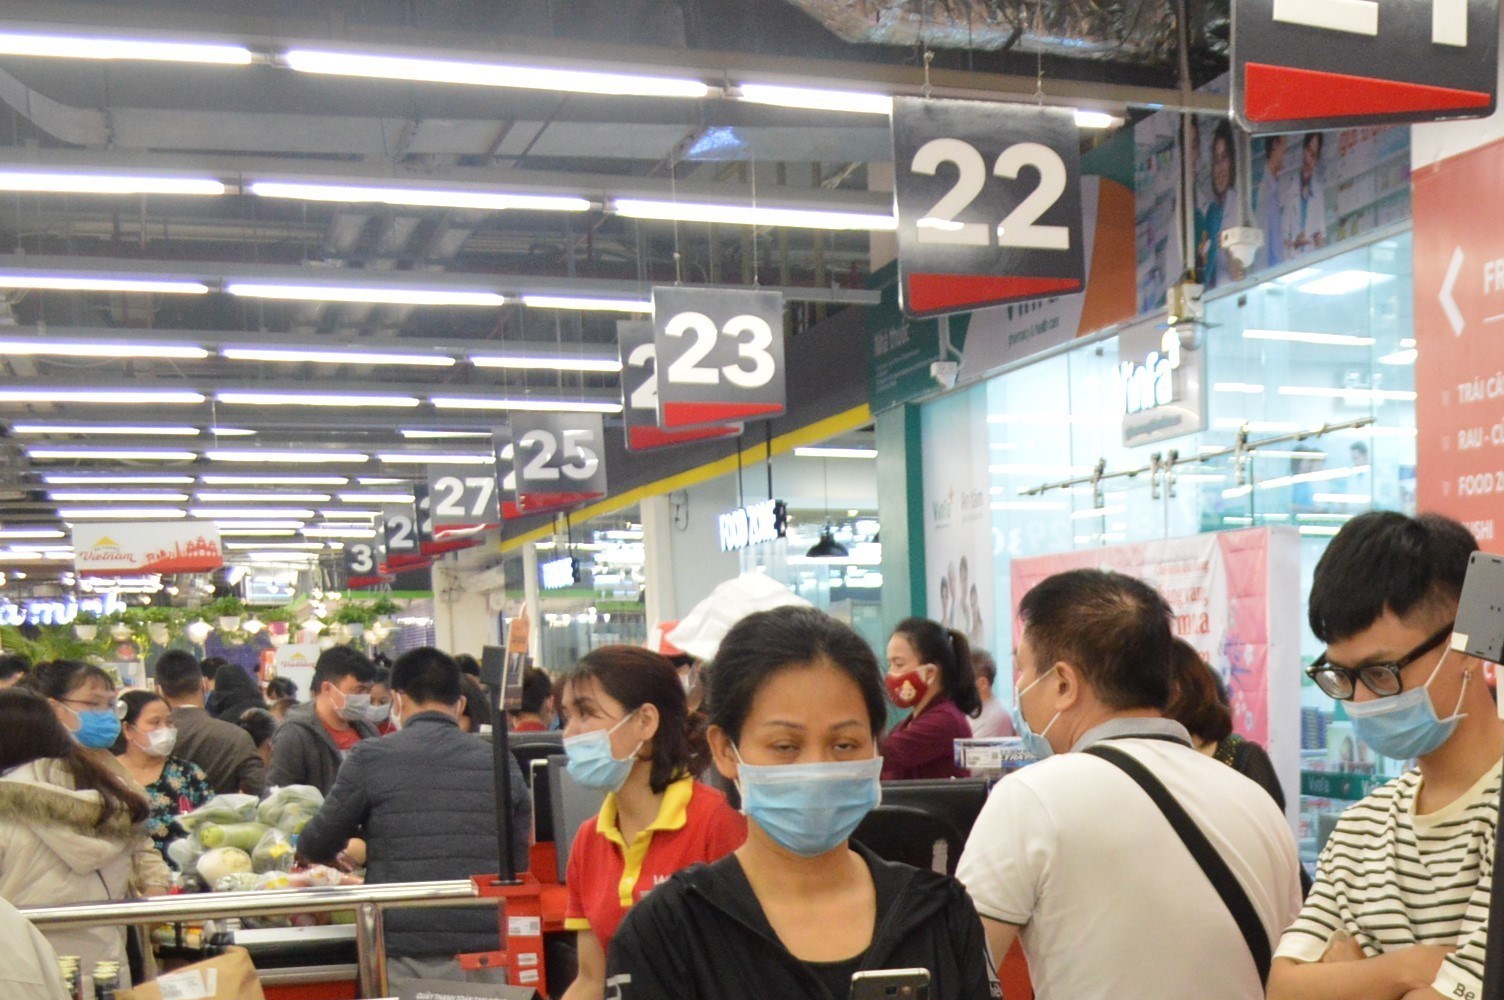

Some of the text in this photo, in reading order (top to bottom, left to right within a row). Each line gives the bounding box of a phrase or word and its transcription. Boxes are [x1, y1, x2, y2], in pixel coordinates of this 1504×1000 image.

[911, 138, 1069, 250] 22
[665, 311, 776, 388] 23
[628, 343, 658, 409] 2
[1457, 376, 1485, 404] TRÁI
[520, 429, 599, 480] 25
[1458, 428, 1482, 449] RAU
[434, 476, 494, 516] 27
[1458, 472, 1494, 496] FOOD
[387, 516, 415, 548] 2
[1463, 519, 1494, 542] USHI
[351, 544, 373, 573] 3
